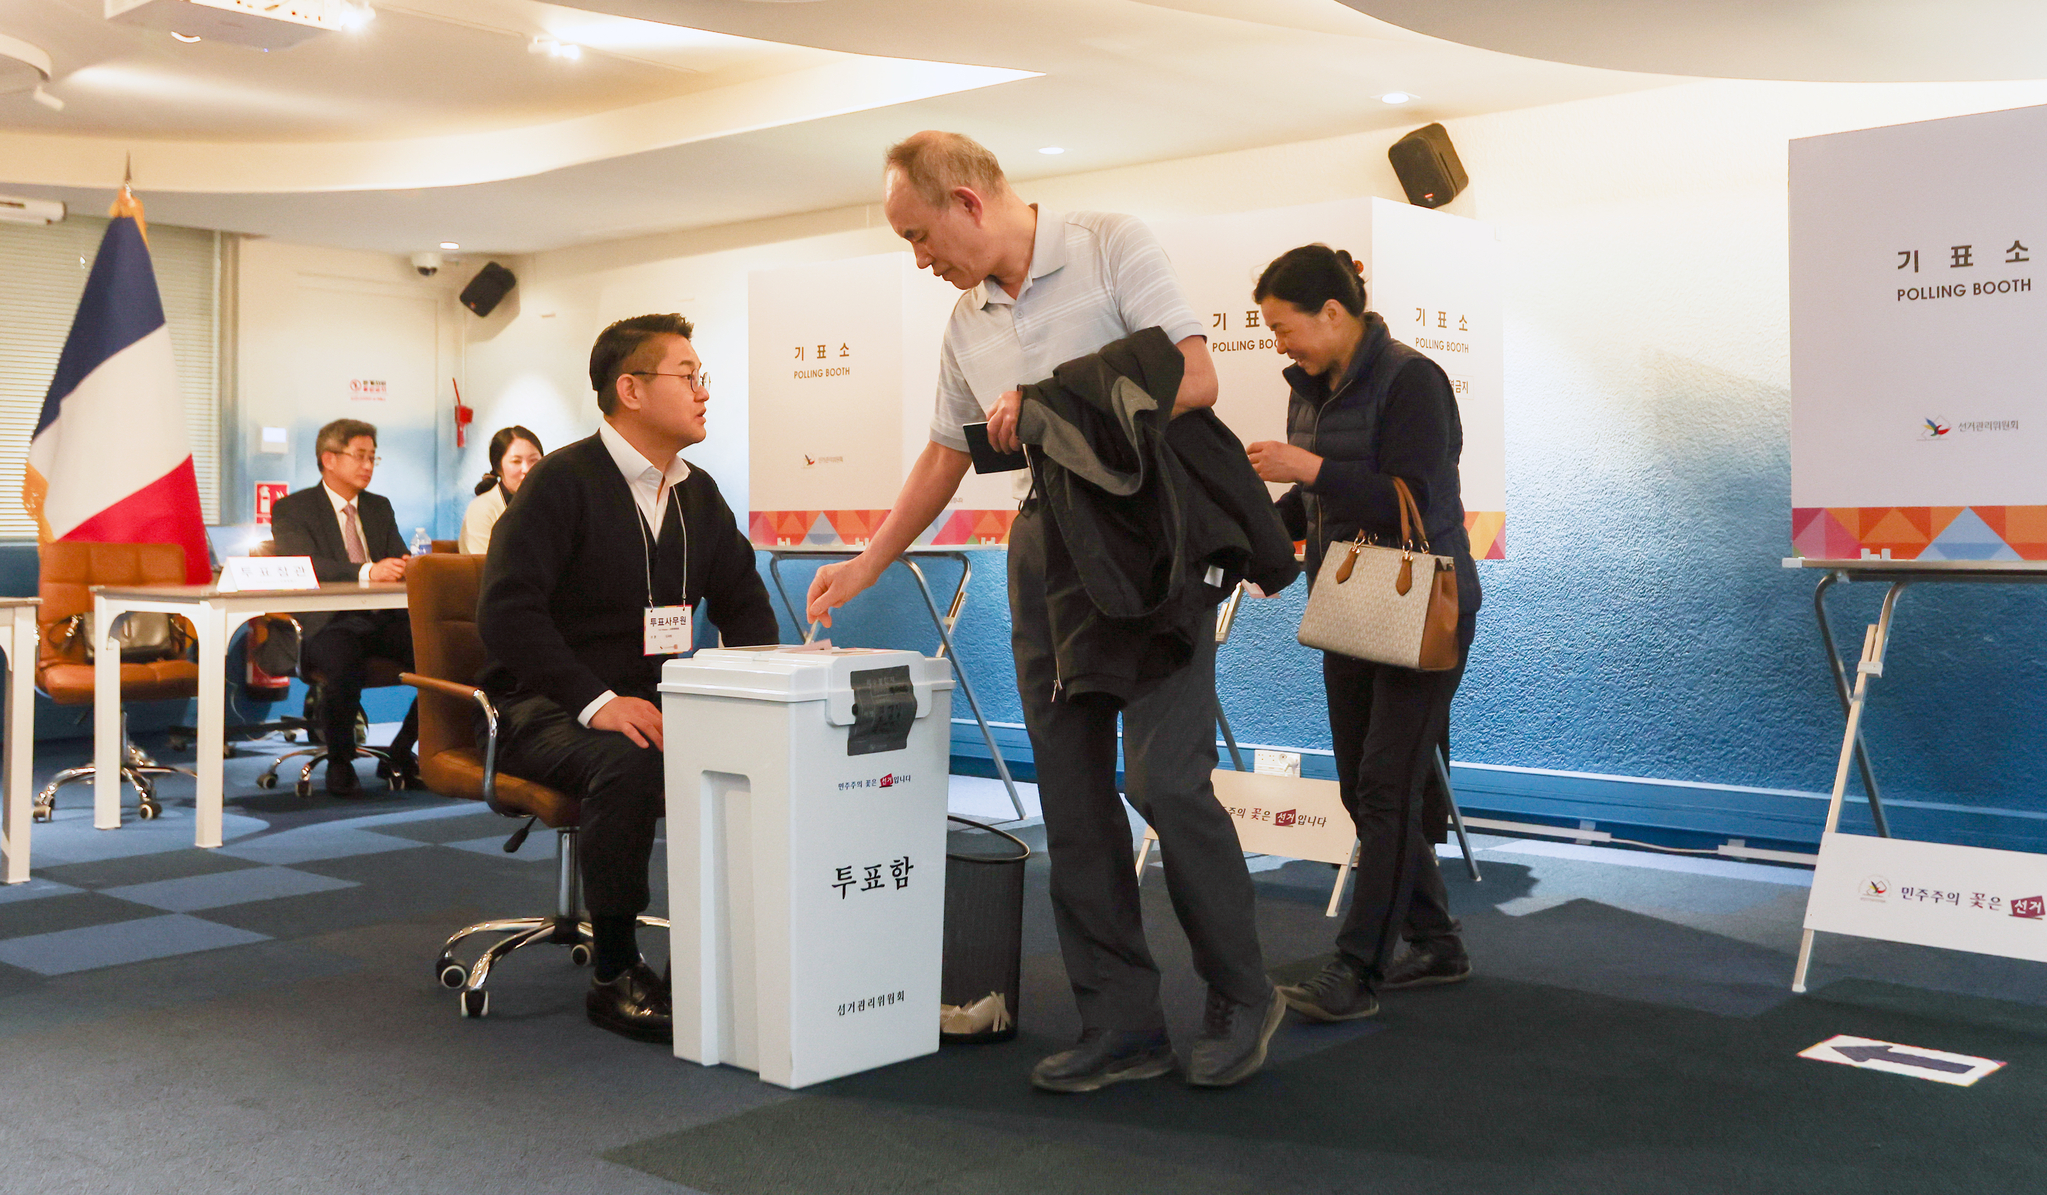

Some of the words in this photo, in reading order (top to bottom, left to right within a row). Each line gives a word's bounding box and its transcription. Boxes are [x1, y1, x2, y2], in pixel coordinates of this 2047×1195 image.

[1897, 283, 1967, 302] POLLING
[1972, 277, 2032, 296] BOOTH
[1212, 340, 1255, 353] POLLING
[1415, 337, 1445, 351] POLLING
[1446, 341, 1469, 354] BOOTH
[793, 369, 824, 380] POLLING
[825, 366, 851, 378] BOOTH
[1957, 419, 2019, 432] 선거관리위원회
[649, 615, 687, 627] 투표사무원
[1223, 806, 1247, 819] 주의
[1250, 807, 1271, 822] 꽃은
[831, 855, 915, 900] 투표함
[1901, 886, 1960, 907] 민주주의
[1969, 891, 2002, 911] 꽃은
[2014, 899, 2043, 915] 선거
[836, 989, 906, 1018] 선거관리위원회
